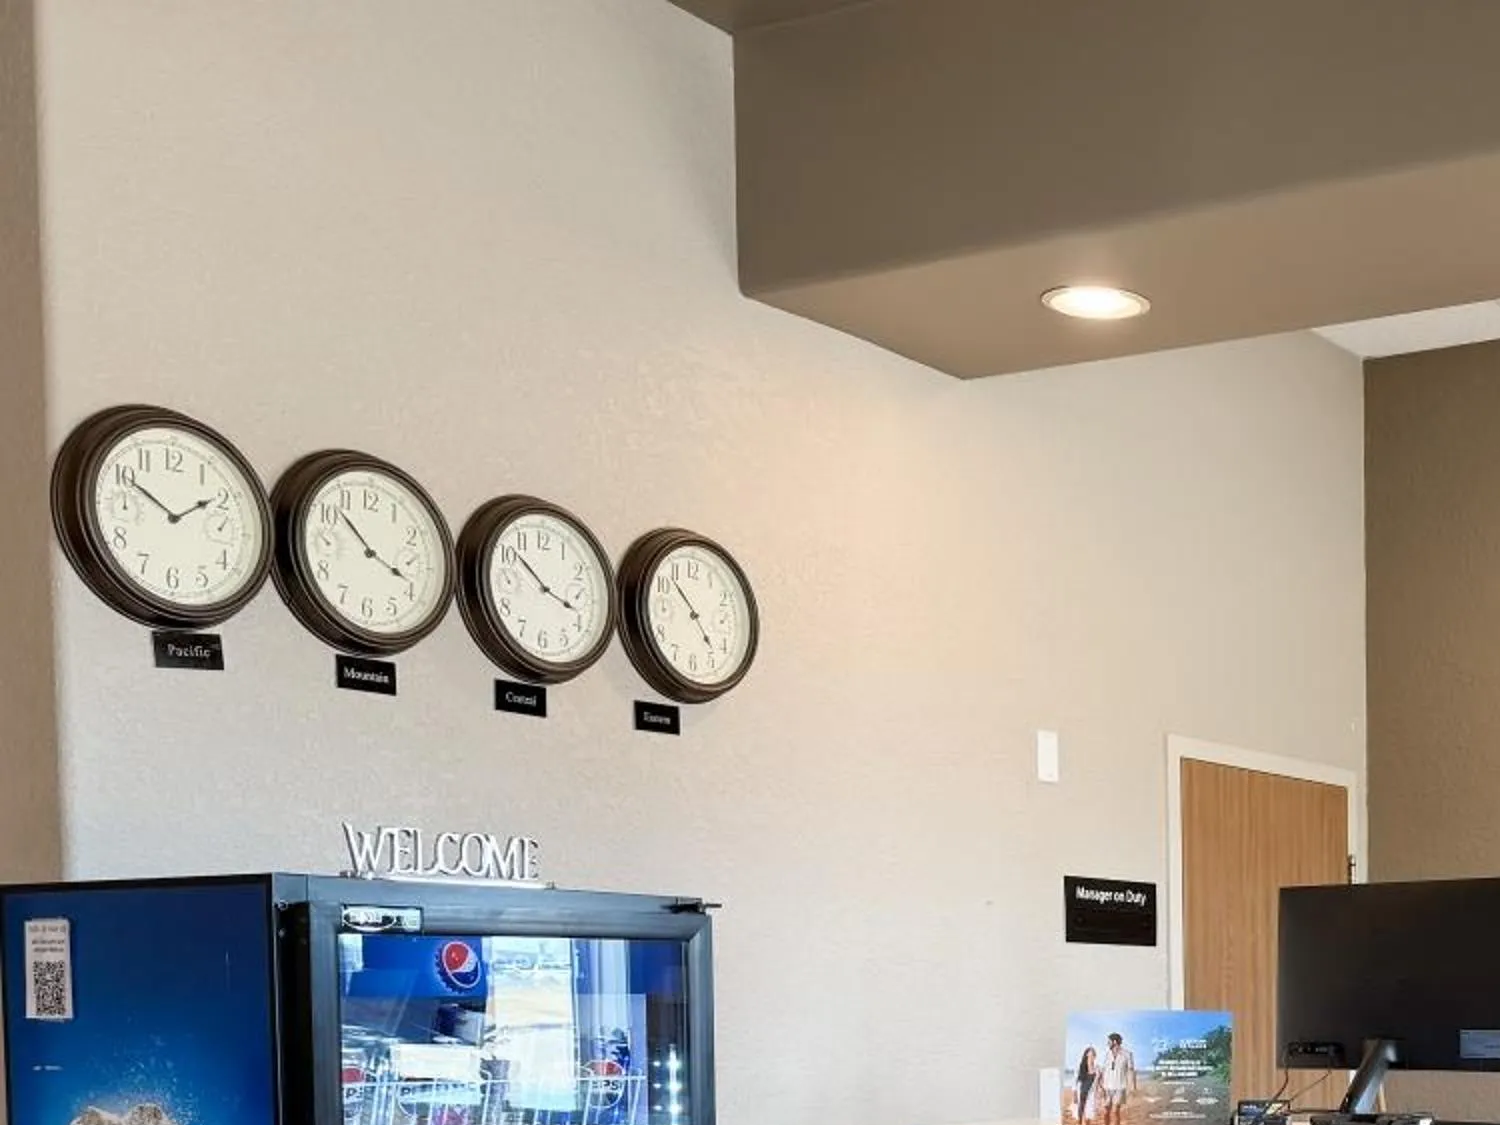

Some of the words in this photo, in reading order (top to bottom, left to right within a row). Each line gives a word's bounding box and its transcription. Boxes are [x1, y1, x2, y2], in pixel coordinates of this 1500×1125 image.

[138, 448, 150, 473] 11
[165, 447, 184, 472] 12
[217, 487, 229, 510] 2
[340, 490, 350, 511] 11
[363, 489, 380, 512] 12
[320, 503, 338, 525] 10
[113, 526, 127, 549] 8
[406, 526, 417, 547] 2
[136, 553, 149, 574] 7
[215, 549, 228, 570] 4
[317, 559, 329, 580] 8
[166, 567, 179, 589] 6
[337, 584, 348, 604] 7
[403, 582, 416, 601] 4
[361, 597, 373, 618] 6
[167, 643, 211, 658] Pacific
[343, 667, 390, 684] Mountain
[341, 821, 539, 881] WELCOME
[1076, 885, 1113, 904] Manager
[1114, 891, 1125, 902] on
[1126, 889, 1147, 907] Duty
